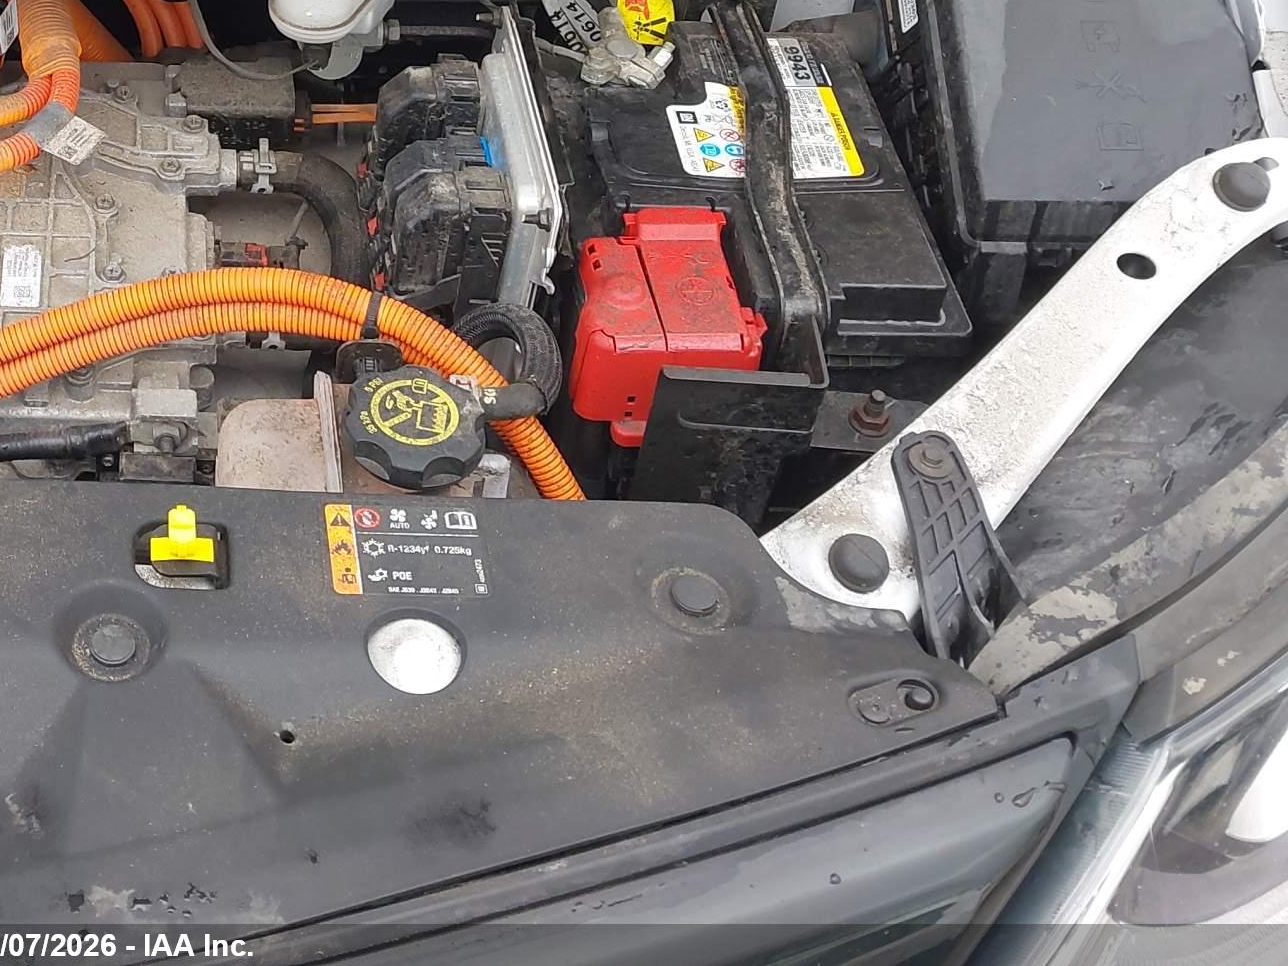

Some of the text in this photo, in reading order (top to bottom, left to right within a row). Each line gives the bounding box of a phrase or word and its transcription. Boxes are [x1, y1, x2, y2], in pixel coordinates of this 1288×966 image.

[784, 46, 811, 81] 9943
[433, 545, 473, 556] 0.725kg
[392, 571, 413, 581] POE
